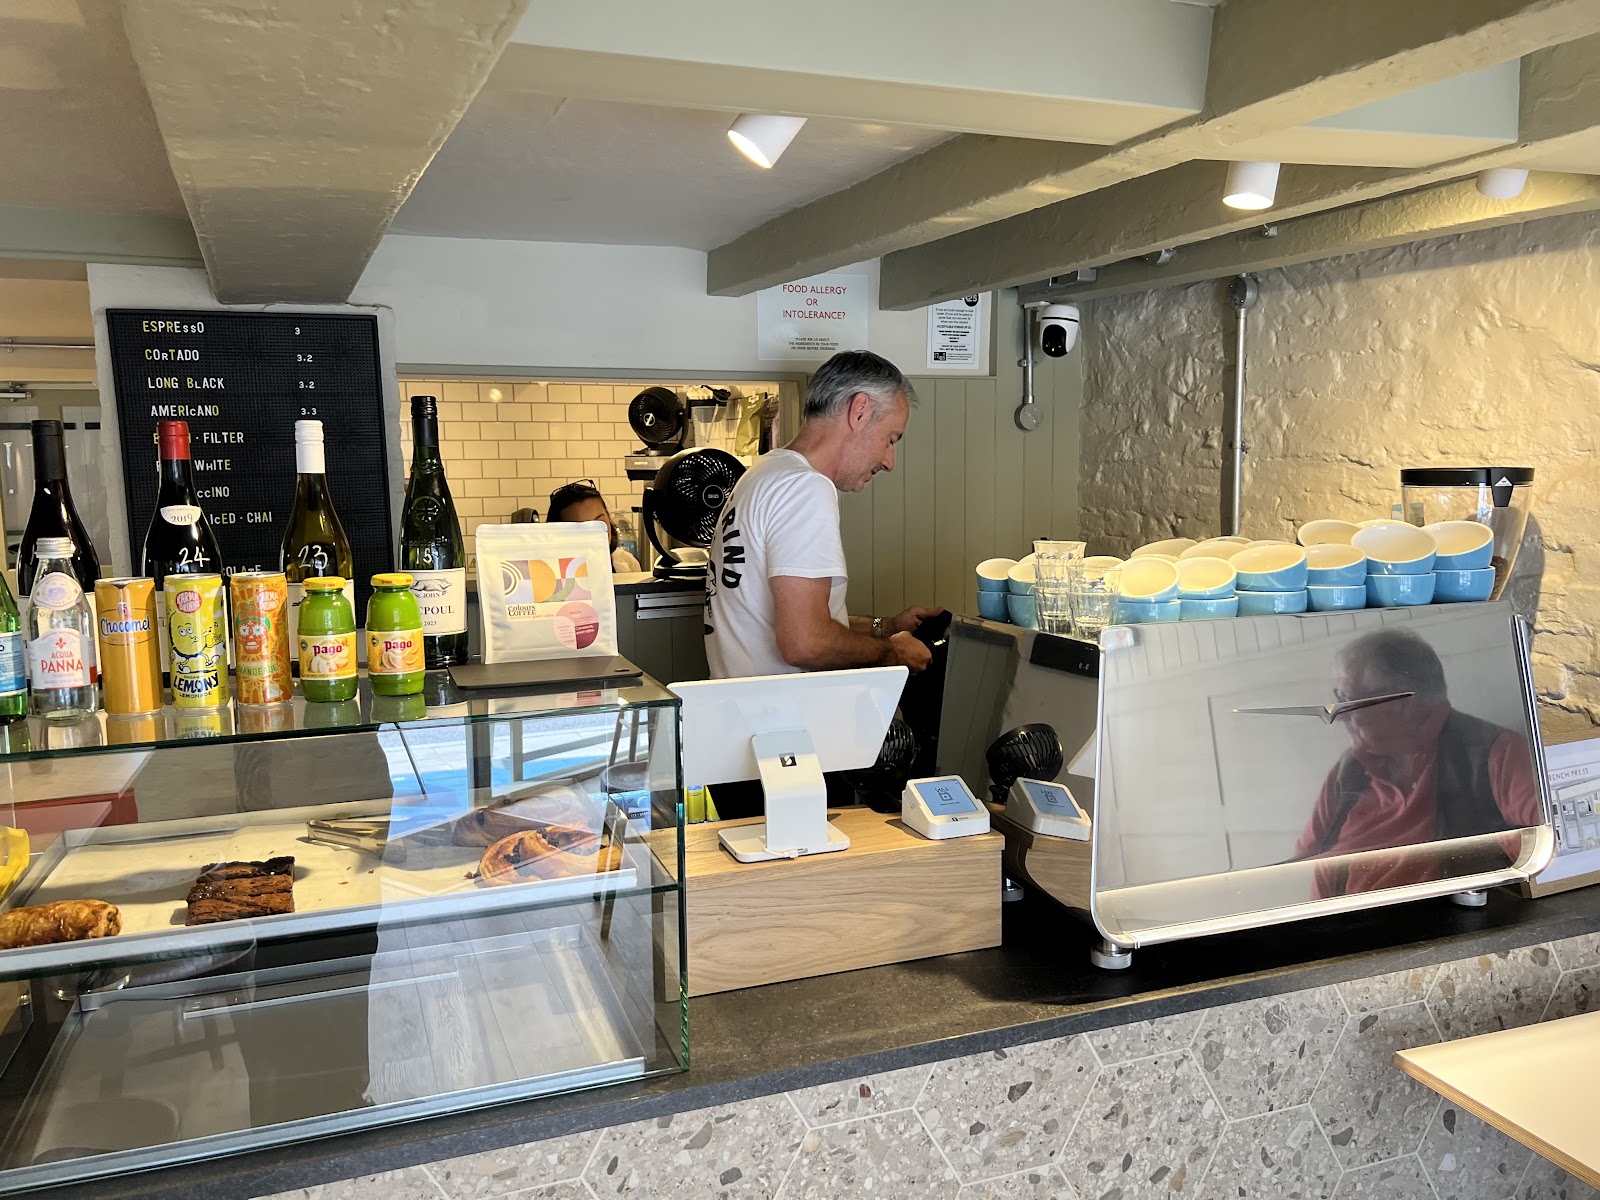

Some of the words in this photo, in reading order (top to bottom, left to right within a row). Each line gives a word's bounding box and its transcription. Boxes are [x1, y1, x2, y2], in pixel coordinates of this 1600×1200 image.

[782, 284, 808, 294] FOOD
[810, 285, 847, 295] ALLERGY
[806, 298, 819, 307] OR
[782, 310, 846, 320] INTOLERANCE?
[294, 327, 300, 335] 3
[296, 354, 313, 362] 3.2
[148, 377, 179, 390] LONG
[298, 381, 315, 389] 3.2
[150, 404, 220, 417] AMERICANO
[203, 431, 244, 444] FILTER
[194, 459, 231, 471] WHITE
[197, 486, 230, 498] CCINO
[171, 513, 193, 523] 2019
[246, 512, 272, 524] CHAI
[179, 546, 210, 567] 24
[297, 545, 328, 570] 23
[419, 605, 455, 615] CPOUL
[100, 615, 151, 637] Chocomel
[51, 650, 74, 659] ACQUA
[41, 658, 84, 673] PANNA
[173, 671, 219, 693] LEMONY
[1549, 772, 1570, 781] RENCH
[1571, 767, 1589, 776] PRESS
